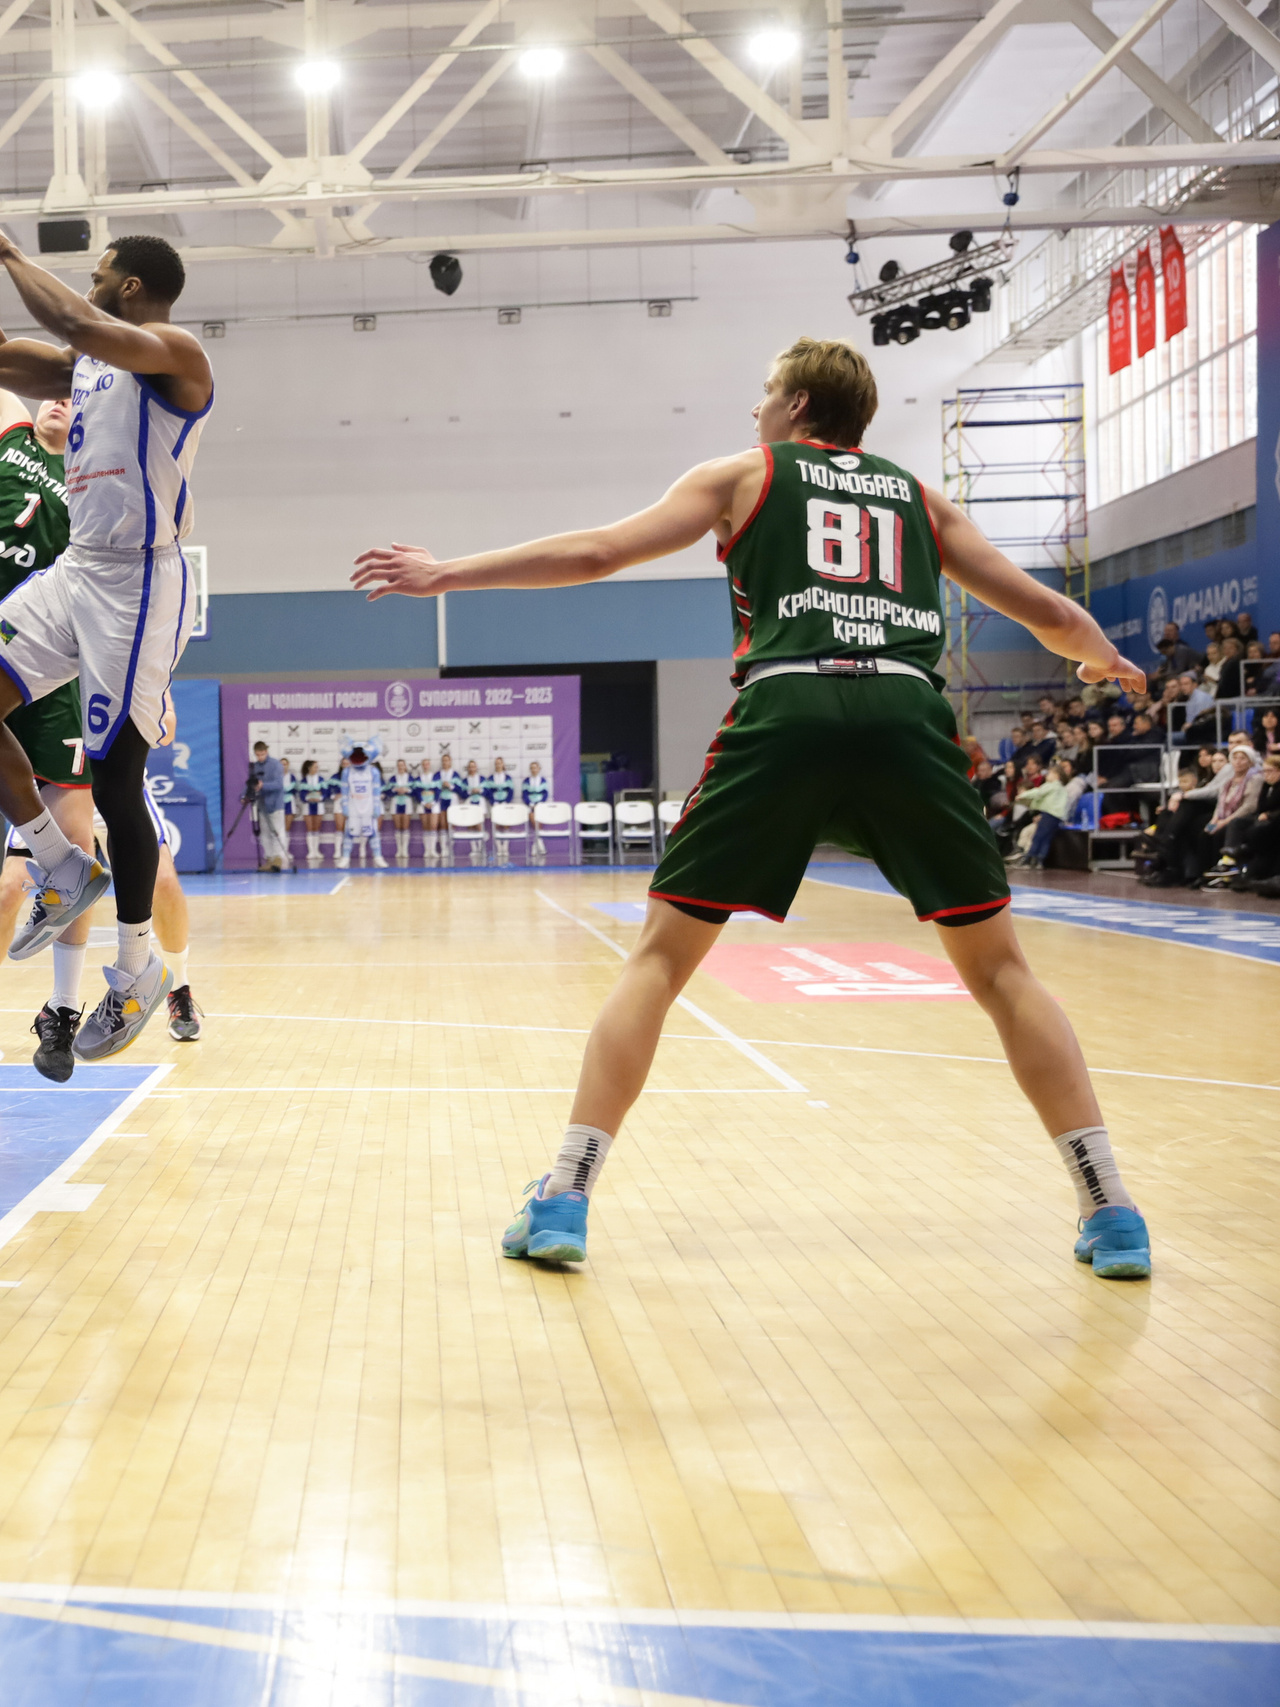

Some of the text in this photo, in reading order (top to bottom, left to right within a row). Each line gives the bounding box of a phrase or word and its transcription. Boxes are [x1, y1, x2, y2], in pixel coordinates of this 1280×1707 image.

[68, 412, 85, 453] 6
[795, 459, 912, 503] ТЮЛЮБАЕВ
[14, 492, 42, 528] 7
[806, 498, 904, 594] 81
[777, 586, 942, 637] КРАСНОДАРСКИЙ
[1173, 579, 1241, 632] ДИНАМО
[832, 616, 886, 646] КРАЙ
[88, 693, 112, 734] 6
[62, 738, 85, 775] 7
